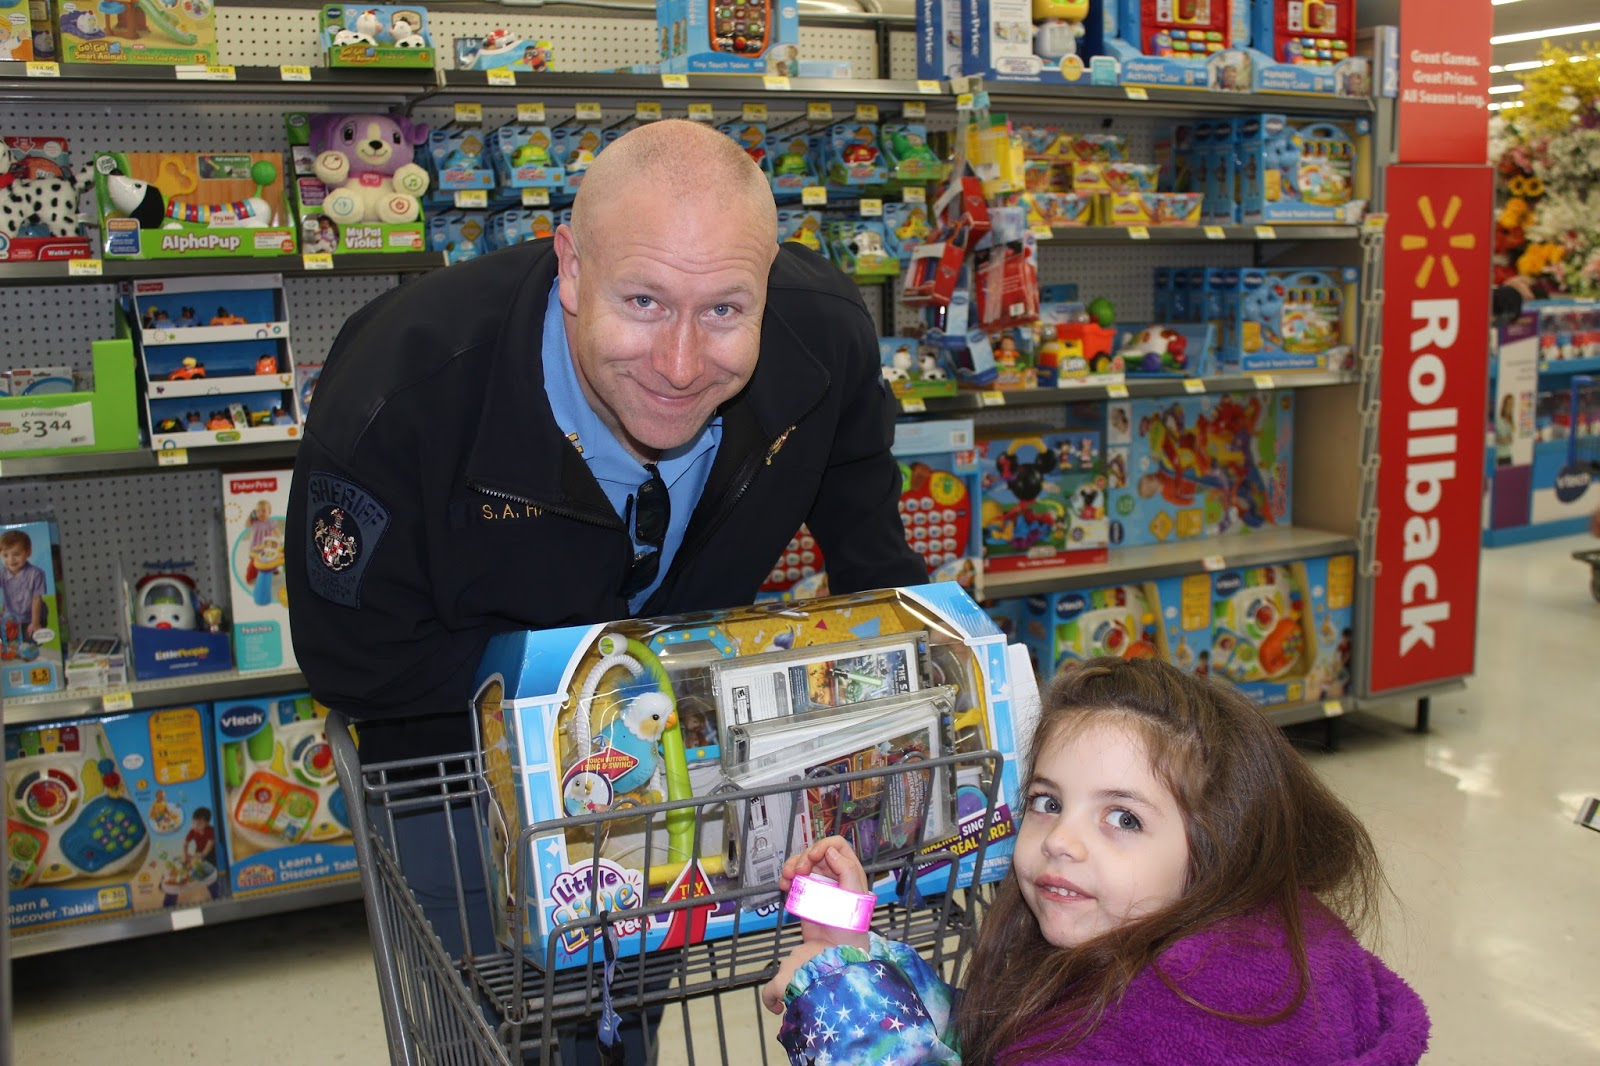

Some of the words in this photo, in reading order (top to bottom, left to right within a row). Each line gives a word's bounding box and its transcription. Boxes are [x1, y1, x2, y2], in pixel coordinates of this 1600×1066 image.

[78, 42, 93, 51] Go!
[94, 43, 108, 51] Go!
[75, 52, 97, 60] Smart
[1410, 49, 1441, 64] Great
[1441, 51, 1481, 66] Games.
[693, 61, 706, 69] Tiny
[1127, 61, 1164, 71] Alphabet
[1126, 72, 1157, 83] Activity
[1412, 70, 1443, 84] Great
[1443, 71, 1478, 86] Prices.
[1402, 89, 1418, 103] All
[1419, 89, 1457, 104] Season
[1457, 92, 1486, 109] Long.
[213, 215, 224, 223] Try
[345, 228, 364, 239] My
[364, 228, 382, 238] Pal
[162, 234, 241, 251] AlphaPup
[345, 238, 383, 249] Violet
[232, 480, 275, 491] Fisher-Price
[1399, 298, 1460, 658] Rollback
[310, 478, 386, 526] SHERIFF
[482, 504, 498, 520] S.
[1057, 599, 1085, 612] vtech
[242, 625, 273, 634] Teaches
[898, 664, 906, 681] THE
[220, 713, 264, 728] vtech
[585, 763, 600, 771] SING
[608, 760, 633, 769] SWING!
[906, 771, 916, 800] MUSEMENT
[962, 811, 1001, 837] SINGG
[950, 837, 979, 856] REAL
[979, 820, 1011, 842] RD!
[279, 856, 312, 870] Learn
[314, 853, 323, 864] &
[279, 865, 330, 882] Discover
[333, 859, 358, 871] Tabl
[556, 869, 618, 904] Little
[679, 881, 703, 896] TY
[8, 902, 37, 913] earn
[40, 898, 50, 908] &
[61, 904, 95, 917] Table
[614, 917, 649, 937] Pet
